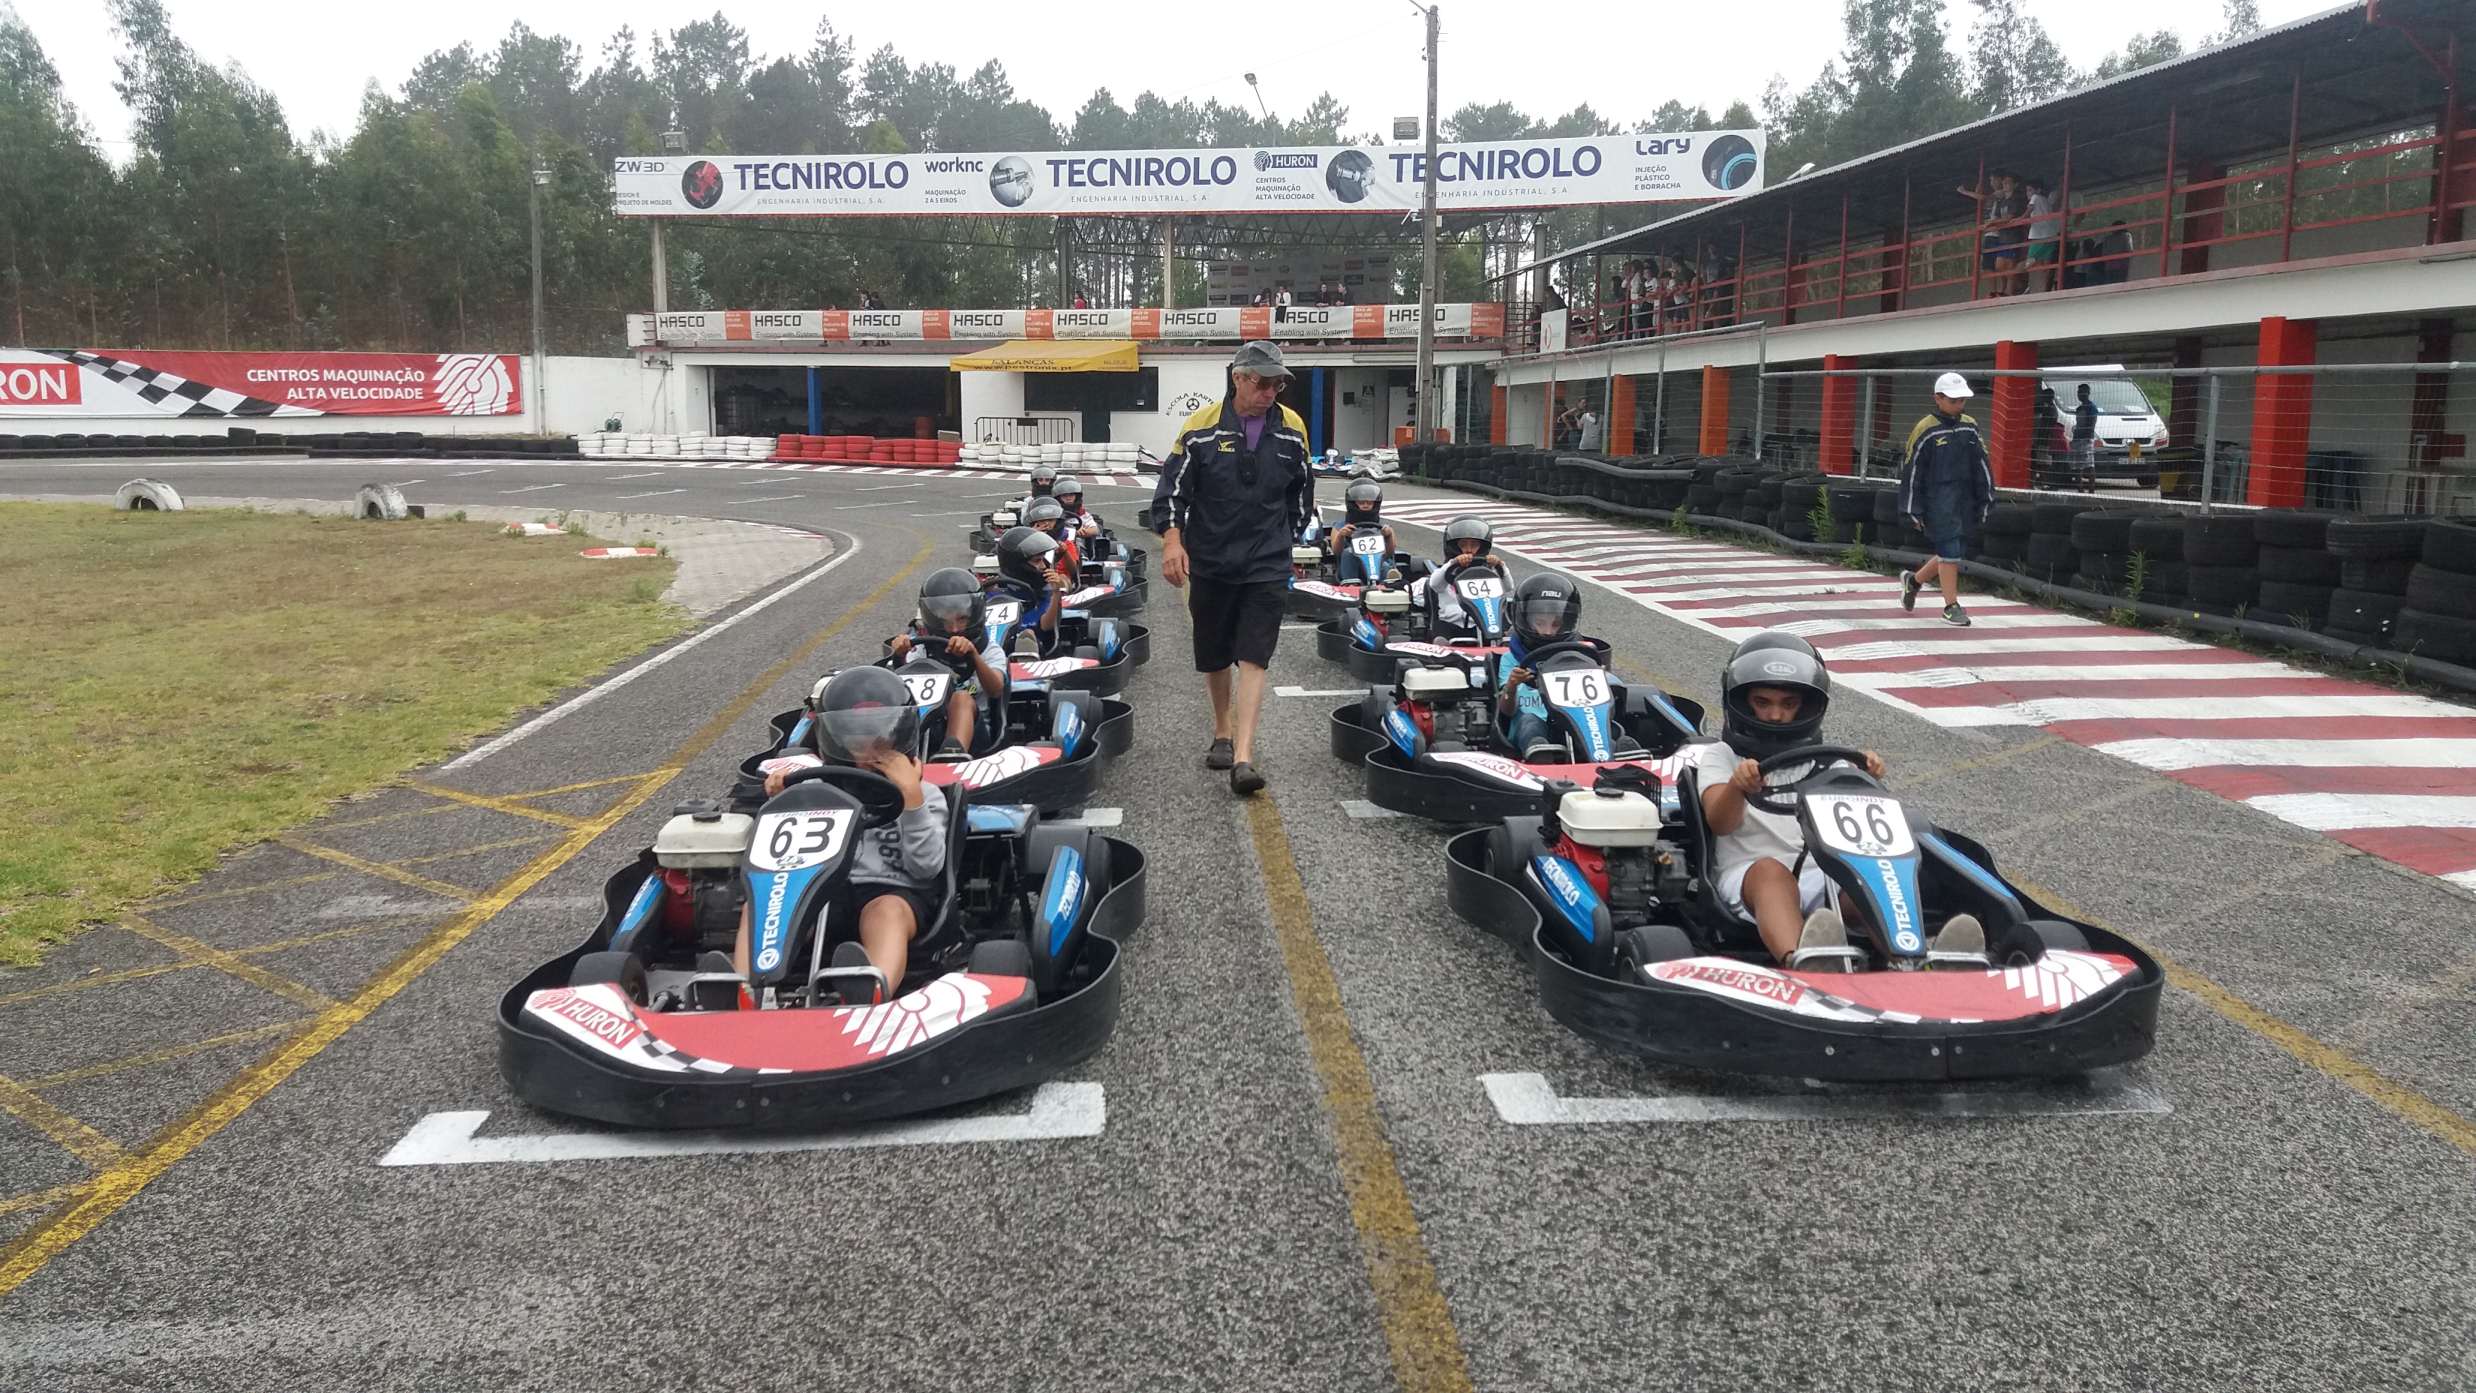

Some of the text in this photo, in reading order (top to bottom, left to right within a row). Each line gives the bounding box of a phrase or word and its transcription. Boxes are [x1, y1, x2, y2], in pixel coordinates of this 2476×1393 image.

[615, 161, 665, 173] ZW3D
[924, 156, 984, 173] worknc
[1275, 155, 1315, 167] HURON
[1388, 145, 1603, 183] TECNIROLO
[733, 160, 910, 191] TECNIROLO
[1045, 155, 1238, 188] TECNIROLO
[1635, 165, 1667, 173] INJEÇÃO
[1635, 174, 1671, 182] PLÁSTICO
[1255, 184, 1301, 193] MAQUINAÇÃO
[1640, 183, 1681, 191] BORRACHA
[1071, 195, 1128, 203] ENGENHARIA
[1415, 191, 1479, 199] ENENHARIA
[659, 315, 705, 328] HASCO
[755, 315, 801, 327] HASCO
[852, 314, 901, 327] HASCO
[953, 314, 1003, 327] HASCO
[1057, 313, 1109, 326] HASCO
[1164, 312, 1217, 325] HASCO
[1274, 311, 1329, 324] ASCO
[1389, 308, 1446, 322] HASO
[247, 367, 425, 385] CENTROS MAQUINAÇÃO
[287, 386, 424, 400] ALTA VELOCIDADE
[1358, 537, 1377, 552] 62
[1467, 580, 1492, 596] 64
[903, 678, 936, 701] 8
[1554, 674, 1599, 702] 76
[1518, 695, 1545, 708] COM
[1832, 801, 1894, 846] 66
[769, 816, 836, 859] 63
[1877, 859, 1912, 931] TECNIROLO
[761, 871, 789, 950] TECNIROLO
[1703, 966, 1797, 1001] HURON
[563, 1001, 635, 1045] HURON
